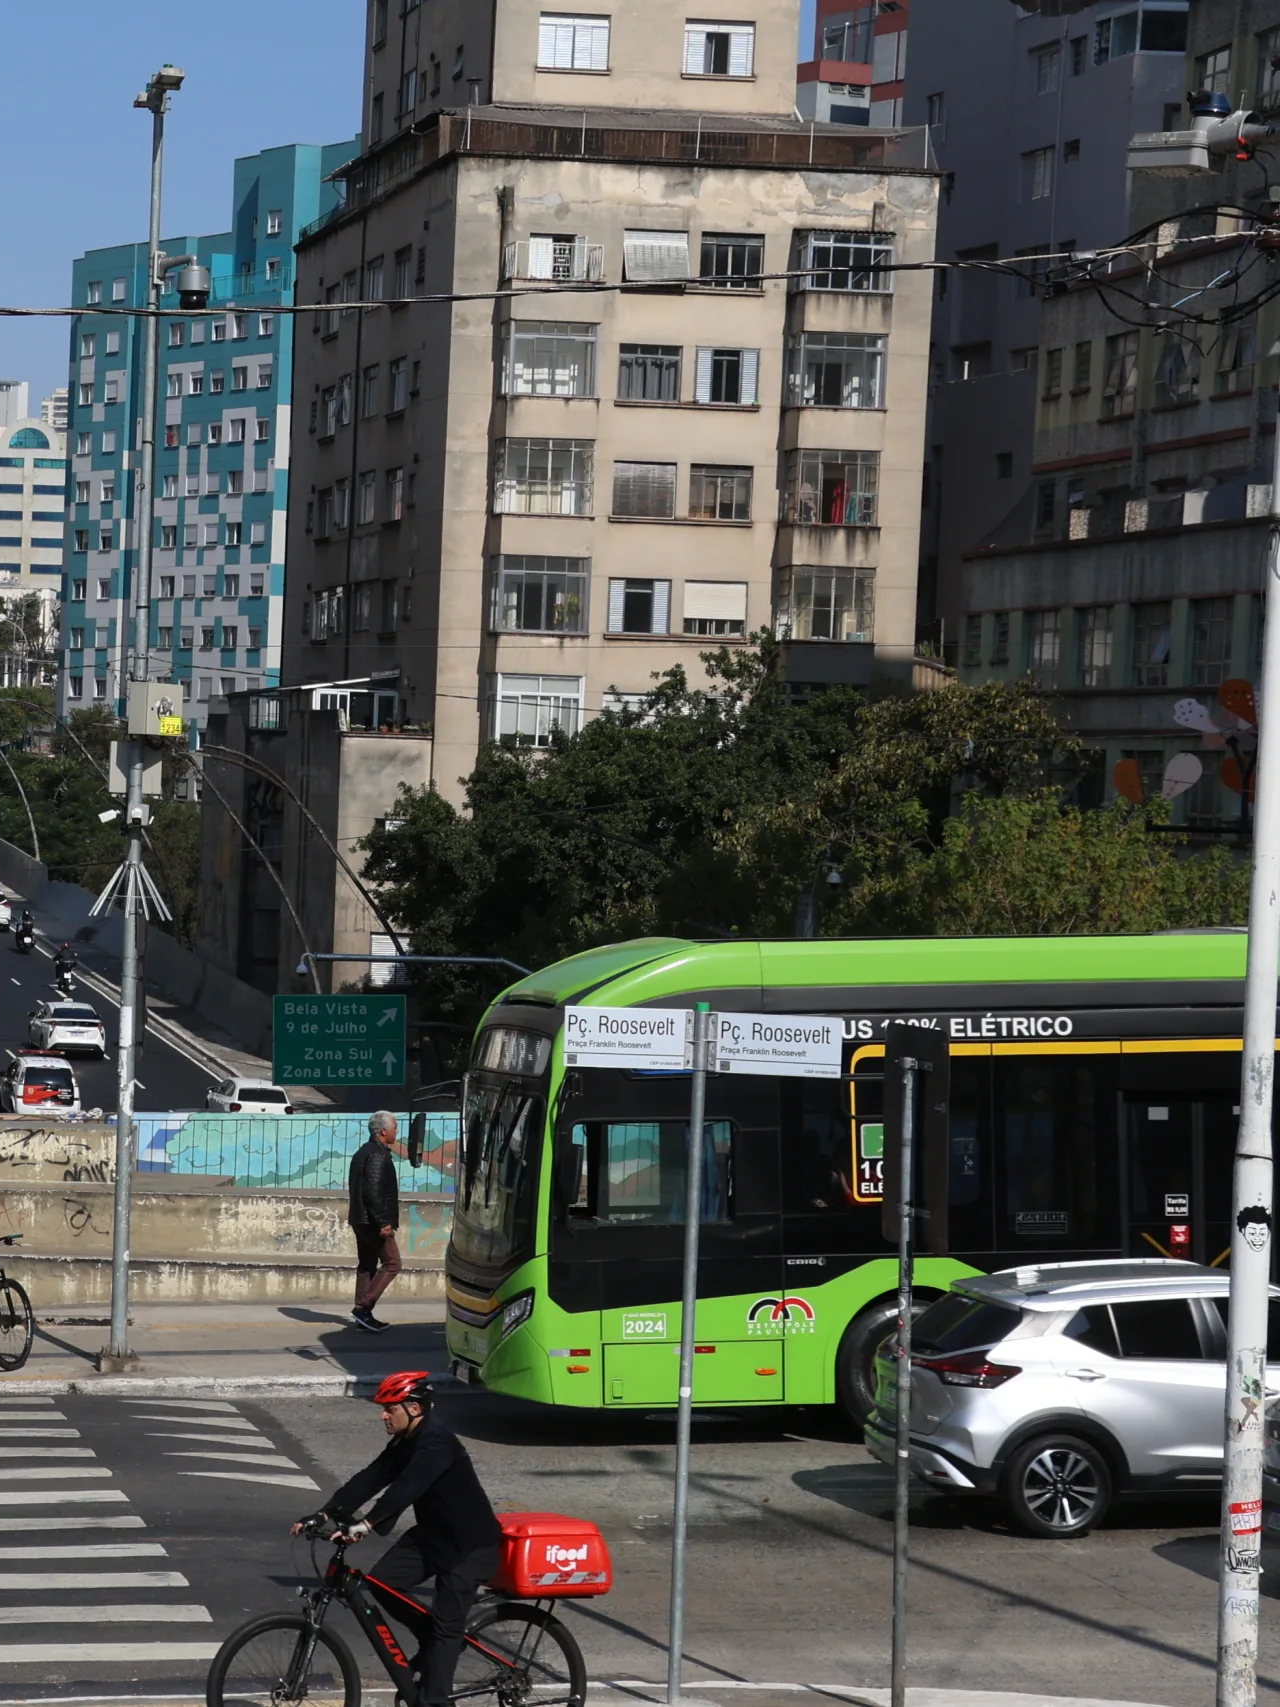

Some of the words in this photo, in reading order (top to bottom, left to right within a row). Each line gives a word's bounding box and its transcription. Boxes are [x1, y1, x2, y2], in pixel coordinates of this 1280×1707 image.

[284, 1003, 318, 1015] Bela
[325, 1003, 367, 1015] Vista
[286, 1022, 295, 1033] 9
[301, 1022, 319, 1034] de
[325, 1022, 367, 1034] Julho
[568, 1014, 592, 1038] Pç.
[599, 1015, 675, 1036] Roosevelt
[950, 1013, 1073, 1037] ELÉTRICO
[721, 1020, 745, 1045] Pç.
[752, 1022, 831, 1045] Roosevelt
[567, 1039, 587, 1048] Praça
[589, 1040, 616, 1048] Franklin
[618, 1041, 652, 1049] Roosevelt
[304, 1048, 343, 1060] Zona
[349, 1048, 373, 1060] Sul
[721, 1046, 740, 1055] Praça
[742, 1047, 770, 1055] Franklin
[772, 1048, 807, 1057] Roosevelt
[283, 1065, 321, 1078] Zona
[327, 1065, 373, 1078] Leste
[625, 1320, 664, 1334] 2024
[545, 1544, 588, 1564] ifood
